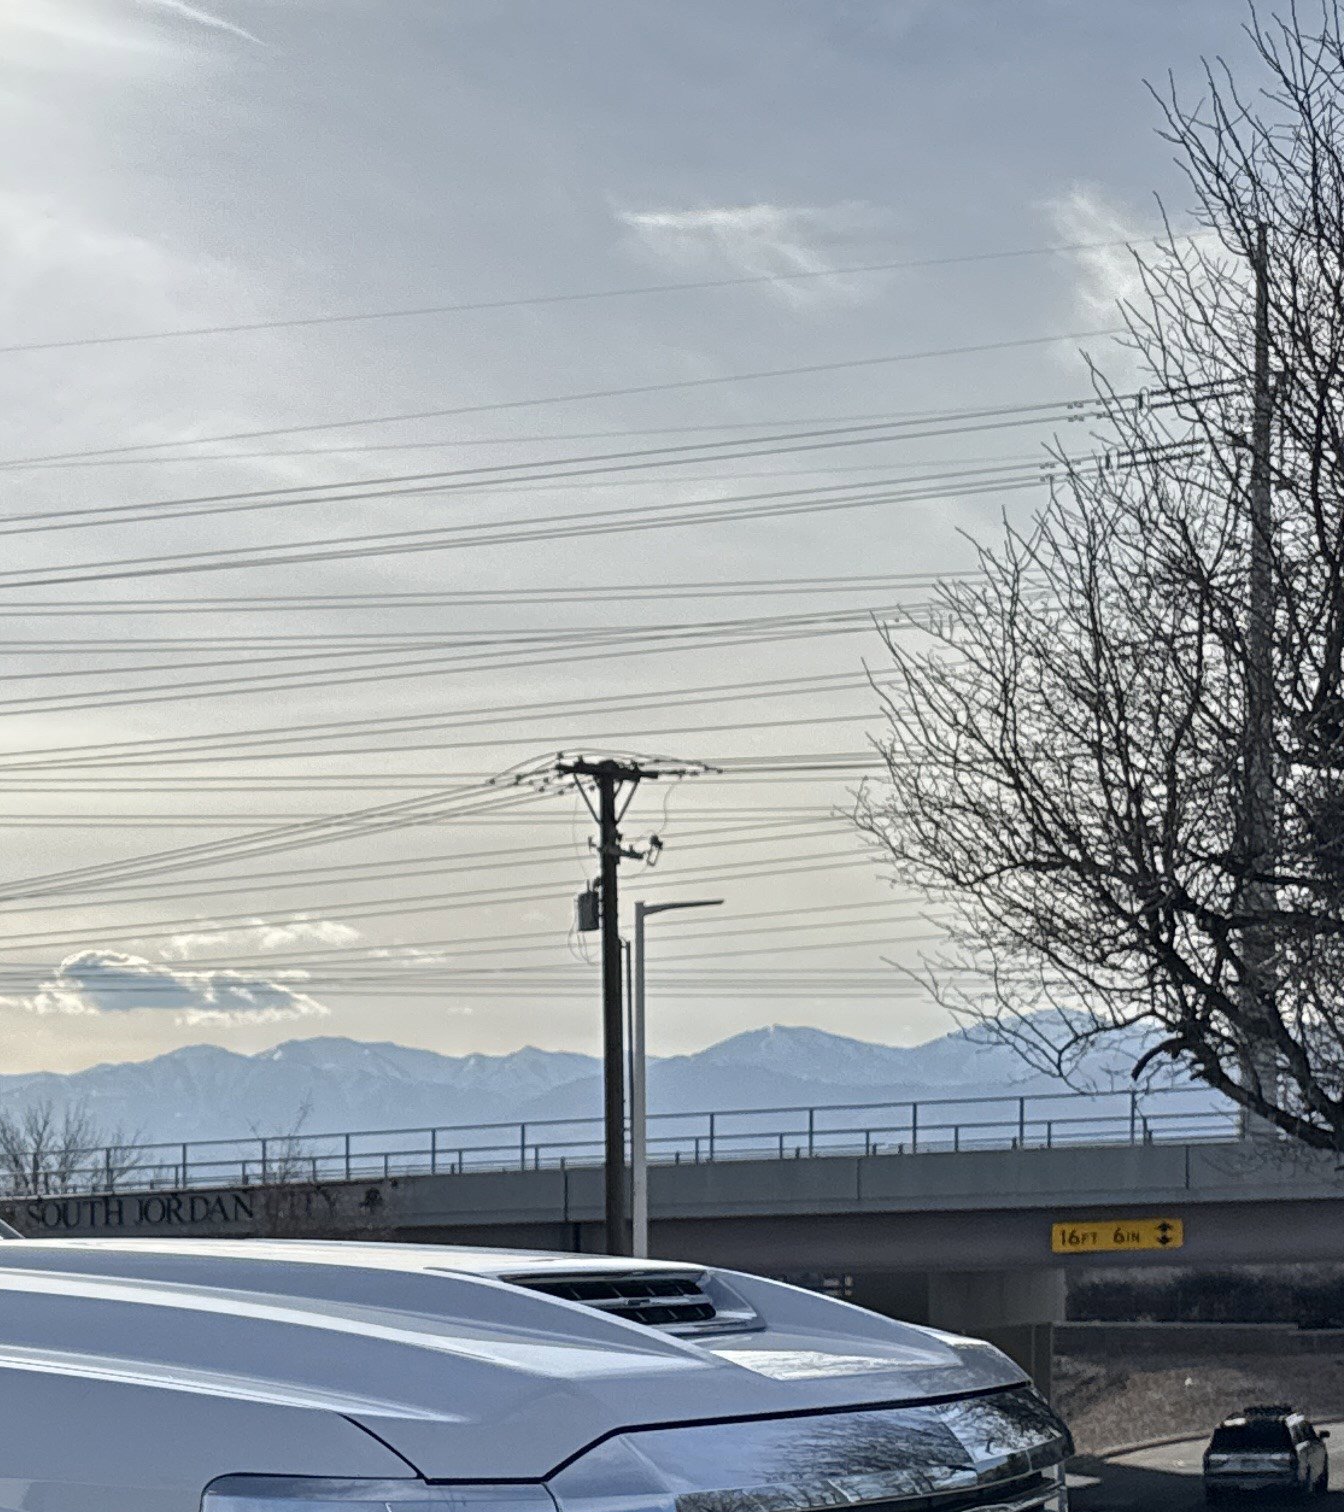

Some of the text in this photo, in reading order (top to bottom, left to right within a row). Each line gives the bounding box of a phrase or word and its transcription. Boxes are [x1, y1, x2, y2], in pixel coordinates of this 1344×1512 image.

[26, 1187, 341, 1228] SOUTH JORDAN ITY
[1061, 1227, 1140, 1246] 16FT 6IN
